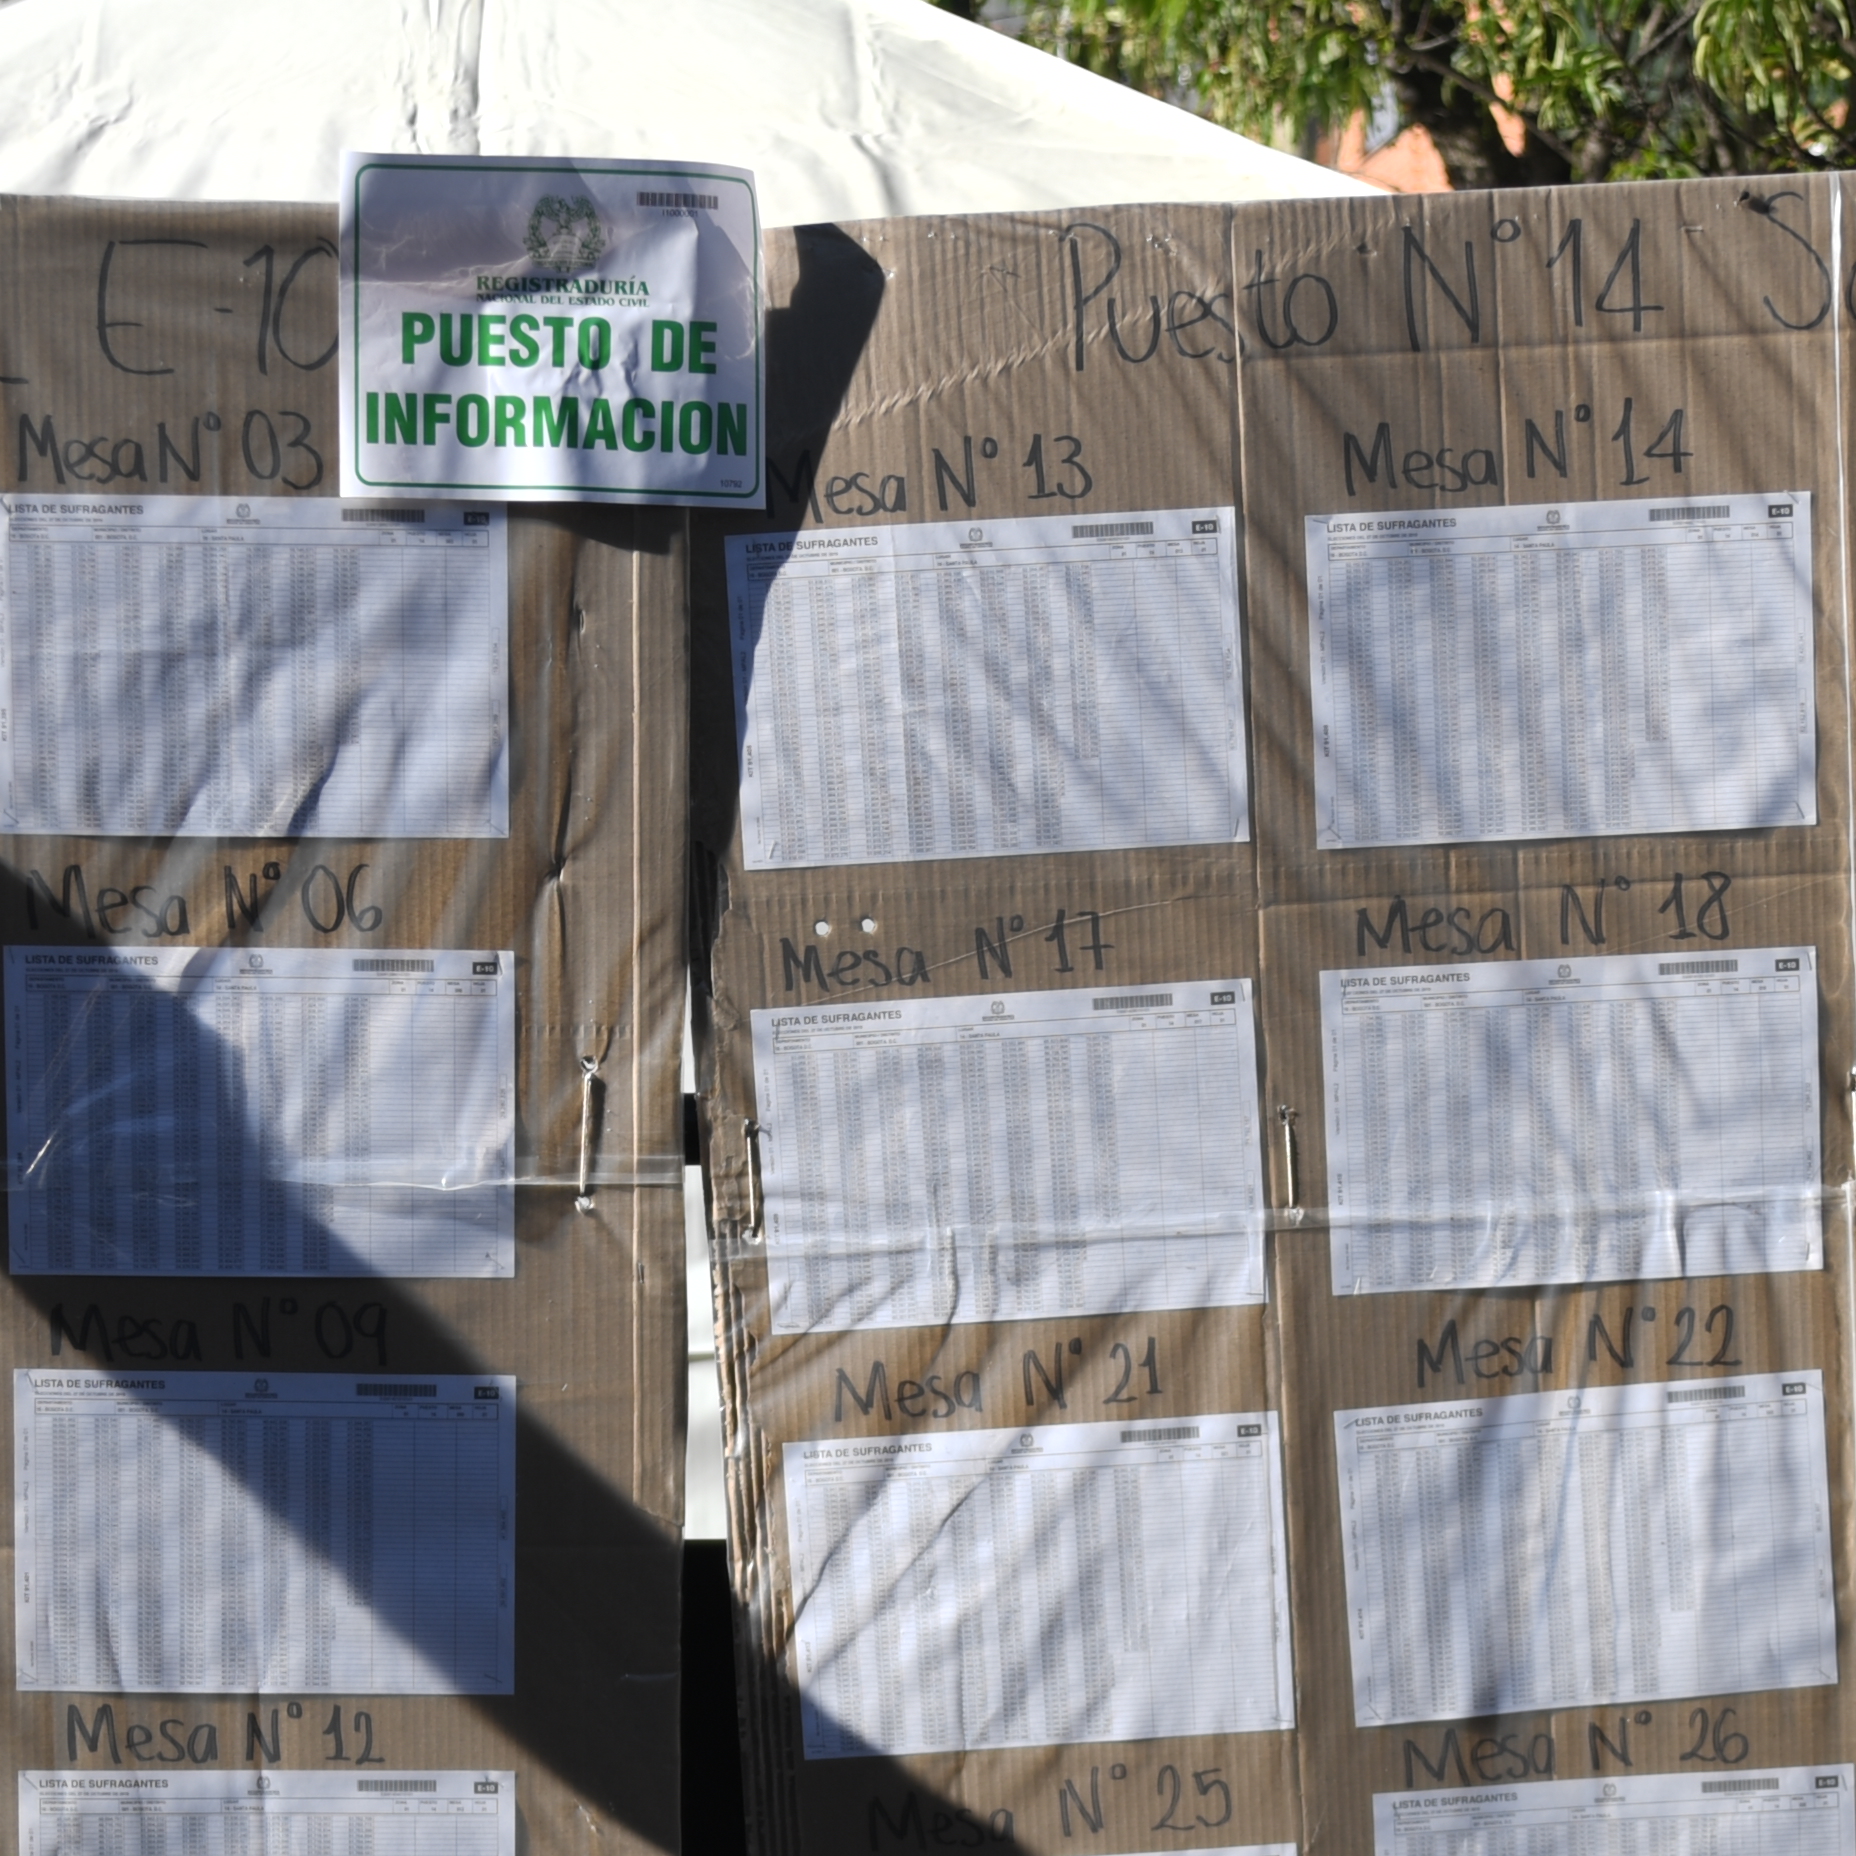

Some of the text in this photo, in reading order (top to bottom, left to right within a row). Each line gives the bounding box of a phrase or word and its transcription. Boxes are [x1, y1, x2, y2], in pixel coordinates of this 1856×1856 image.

[476, 275, 650, 296] REGISTRADURÍA
[476, 293, 650, 308] NACIONAL DEL ESTADO CIVIL
[1058, 222, 1338, 372] Puesto
[1546, 217, 1665, 333] 14
[402, 311, 718, 375] PUESTO DE
[18, 412, 148, 487] Mesa
[242, 410, 325, 491] 03
[365, 391, 747, 457] INFORMACION
[1343, 421, 1499, 497] Mesa
[1611, 396, 1694, 487] 14
[42, 504, 57, 515] DE
[60, 504, 144, 515] SUFRAGANTES
[765, 456, 907, 525] Mesa
[1023, 433, 1093, 500] 13
[779, 541, 793, 552] DE
[796, 536, 879, 550] SUFRAGANTES
[1359, 521, 1374, 532] DE
[1377, 518, 1457, 531] SUFRAGANTES
[26, 862, 191, 938] Mesa
[300, 862, 385, 935] 06
[1356, 893, 1517, 956] Mesa
[1659, 870, 1732, 941] 18
[59, 954, 73, 965] DE
[76, 955, 158, 966] SUFRAGANTES
[780, 936, 931, 993] Mesa
[1045, 909, 1115, 973] 17
[1372, 976, 1387, 987] DE
[1390, 972, 1470, 986] SUFRAGANTES
[804, 1015, 818, 1025] DE
[821, 1010, 902, 1024] SUFRAGANTES
[48, 1299, 203, 1362] Mesa
[314, 1301, 389, 1366] 09
[1416, 1318, 1554, 1388] Mesa
[1666, 1304, 1743, 1368] 22
[67, 1379, 81, 1389] DE
[84, 1379, 165, 1390] SUFRAGANTES
[834, 1360, 983, 1423] Mesa
[1103, 1336, 1164, 1405] 21
[66, 1702, 219, 1765] Mesa
[322, 1703, 385, 1765] 12
[1402, 1728, 1557, 1789] Mesa
[1680, 1707, 1749, 1766] 26
[71, 1779, 86, 1789] DE
[89, 1779, 169, 1789] SUFRAGANTES
[866, 1790, 1016, 1853] Mesa
[1151, 1763, 1233, 1832] 25
